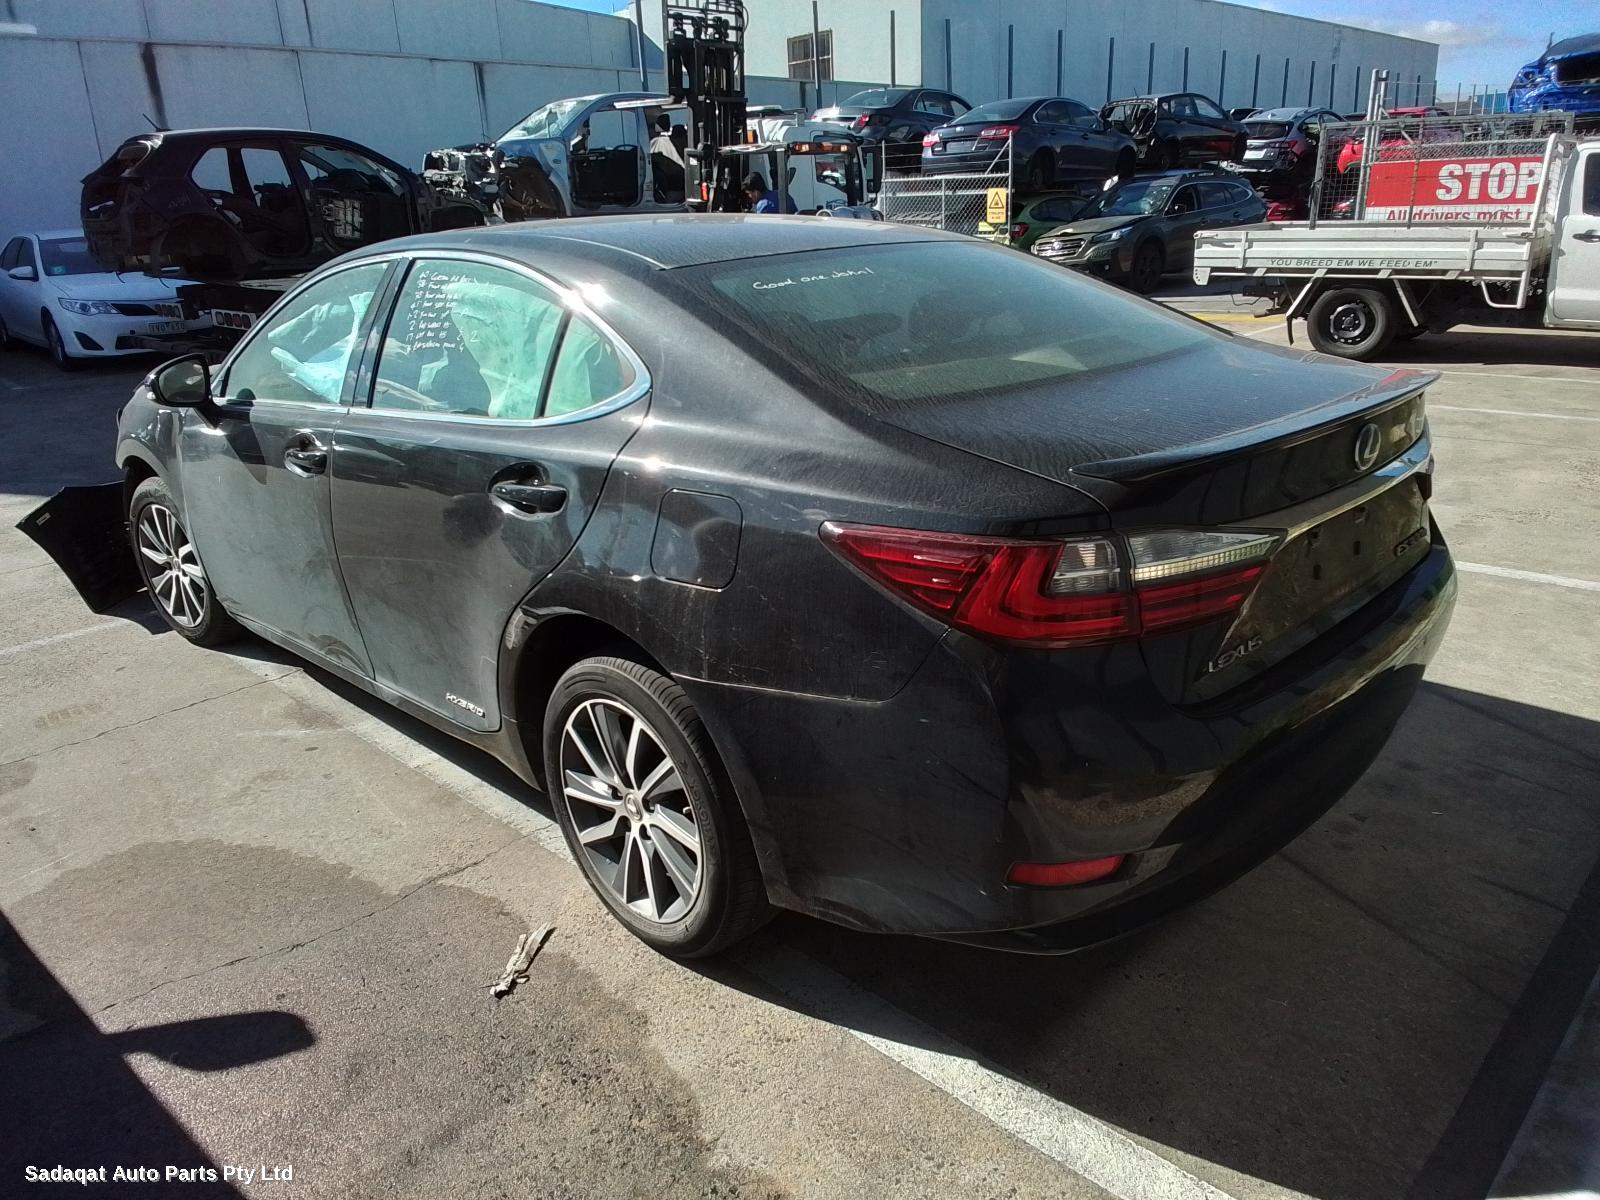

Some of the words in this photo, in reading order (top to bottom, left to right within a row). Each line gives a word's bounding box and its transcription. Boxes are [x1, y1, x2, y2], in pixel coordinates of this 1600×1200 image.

[1436, 162, 1542, 200] STOP
[1413, 208, 1470, 221] drivers
[1296, 259, 1333, 267] BREED
[1337, 259, 1354, 267] EM
[1358, 259, 1375, 267] WE
[1380, 259, 1411, 268] FEED
[752, 278, 797, 289] Good
